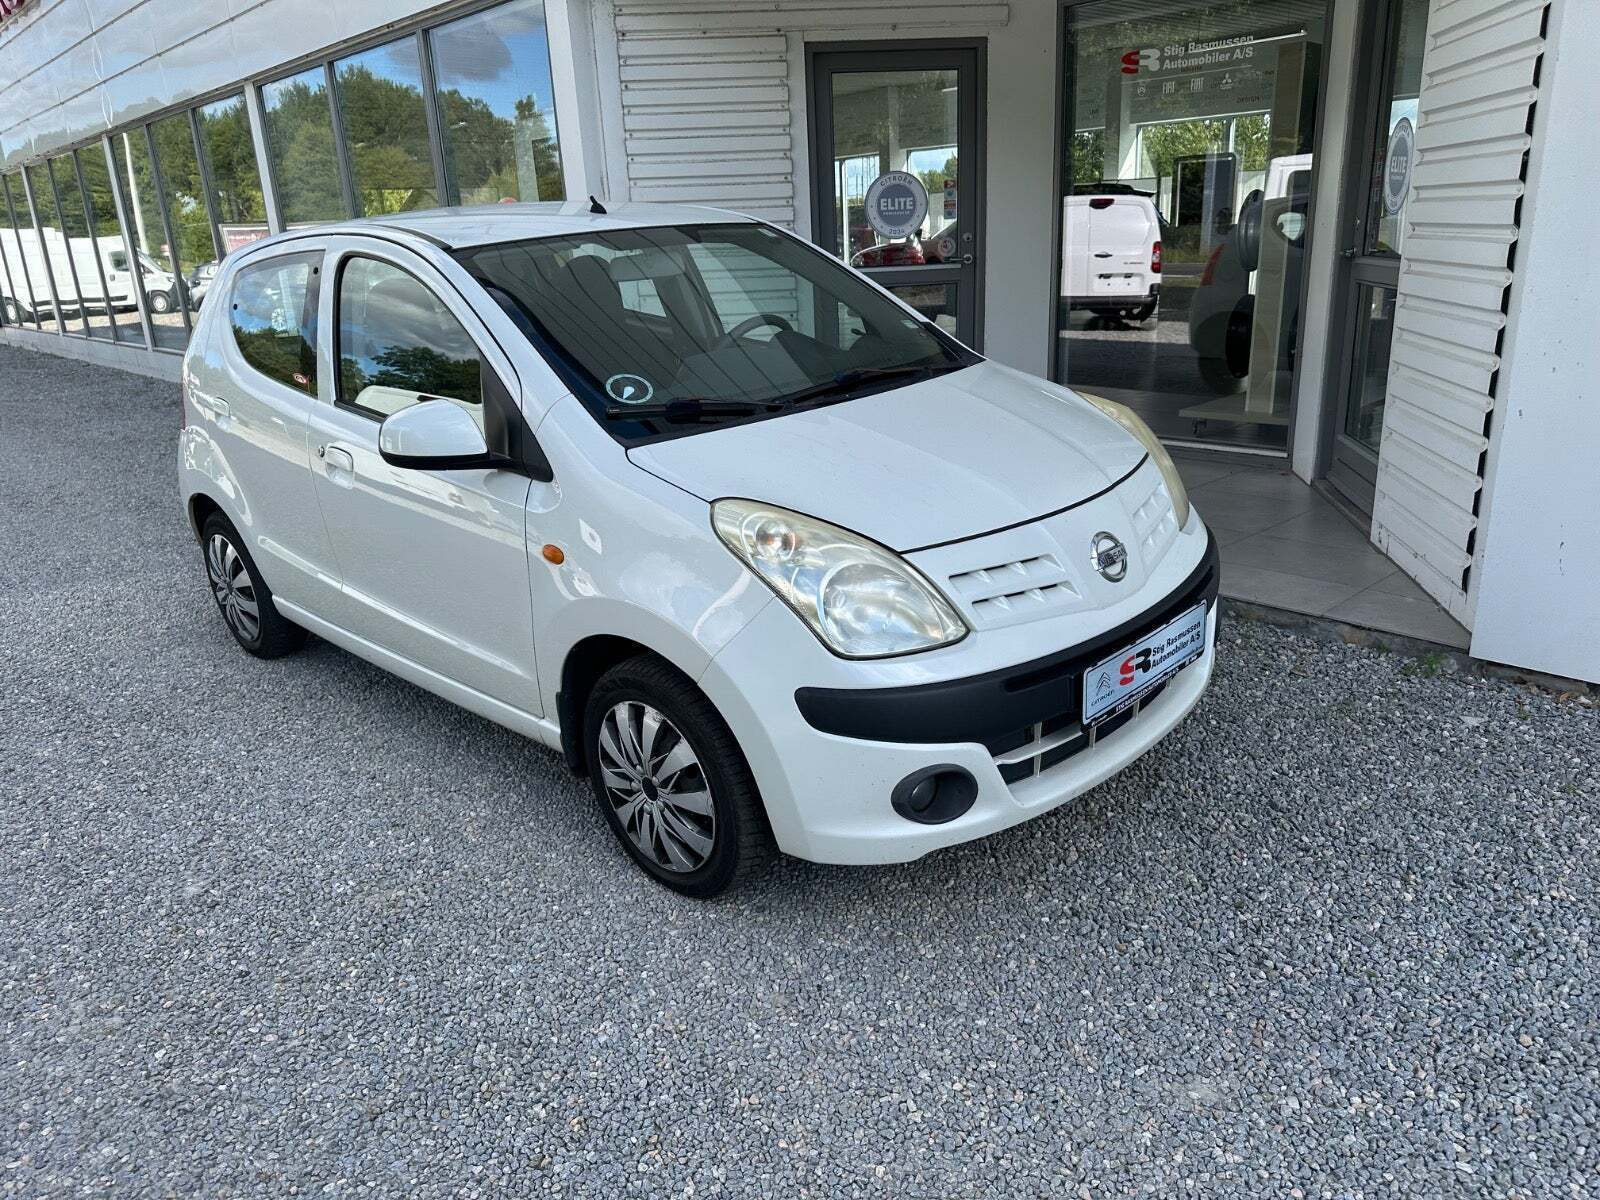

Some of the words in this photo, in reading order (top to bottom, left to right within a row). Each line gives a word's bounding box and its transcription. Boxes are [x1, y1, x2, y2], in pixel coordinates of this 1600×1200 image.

[1163, 45, 1185, 57] Stig
[1188, 35, 1254, 53] Rasmussen
[1162, 51, 1231, 70] Automobiler
[1232, 46, 1254, 60] A/S
[1391, 156, 1407, 173] ELITE
[880, 197, 914, 210] ELITE
[1152, 643, 1165, 657] Stig
[1166, 621, 1200, 647] Rasmussen
[1151, 640, 1189, 669] Automobiler
